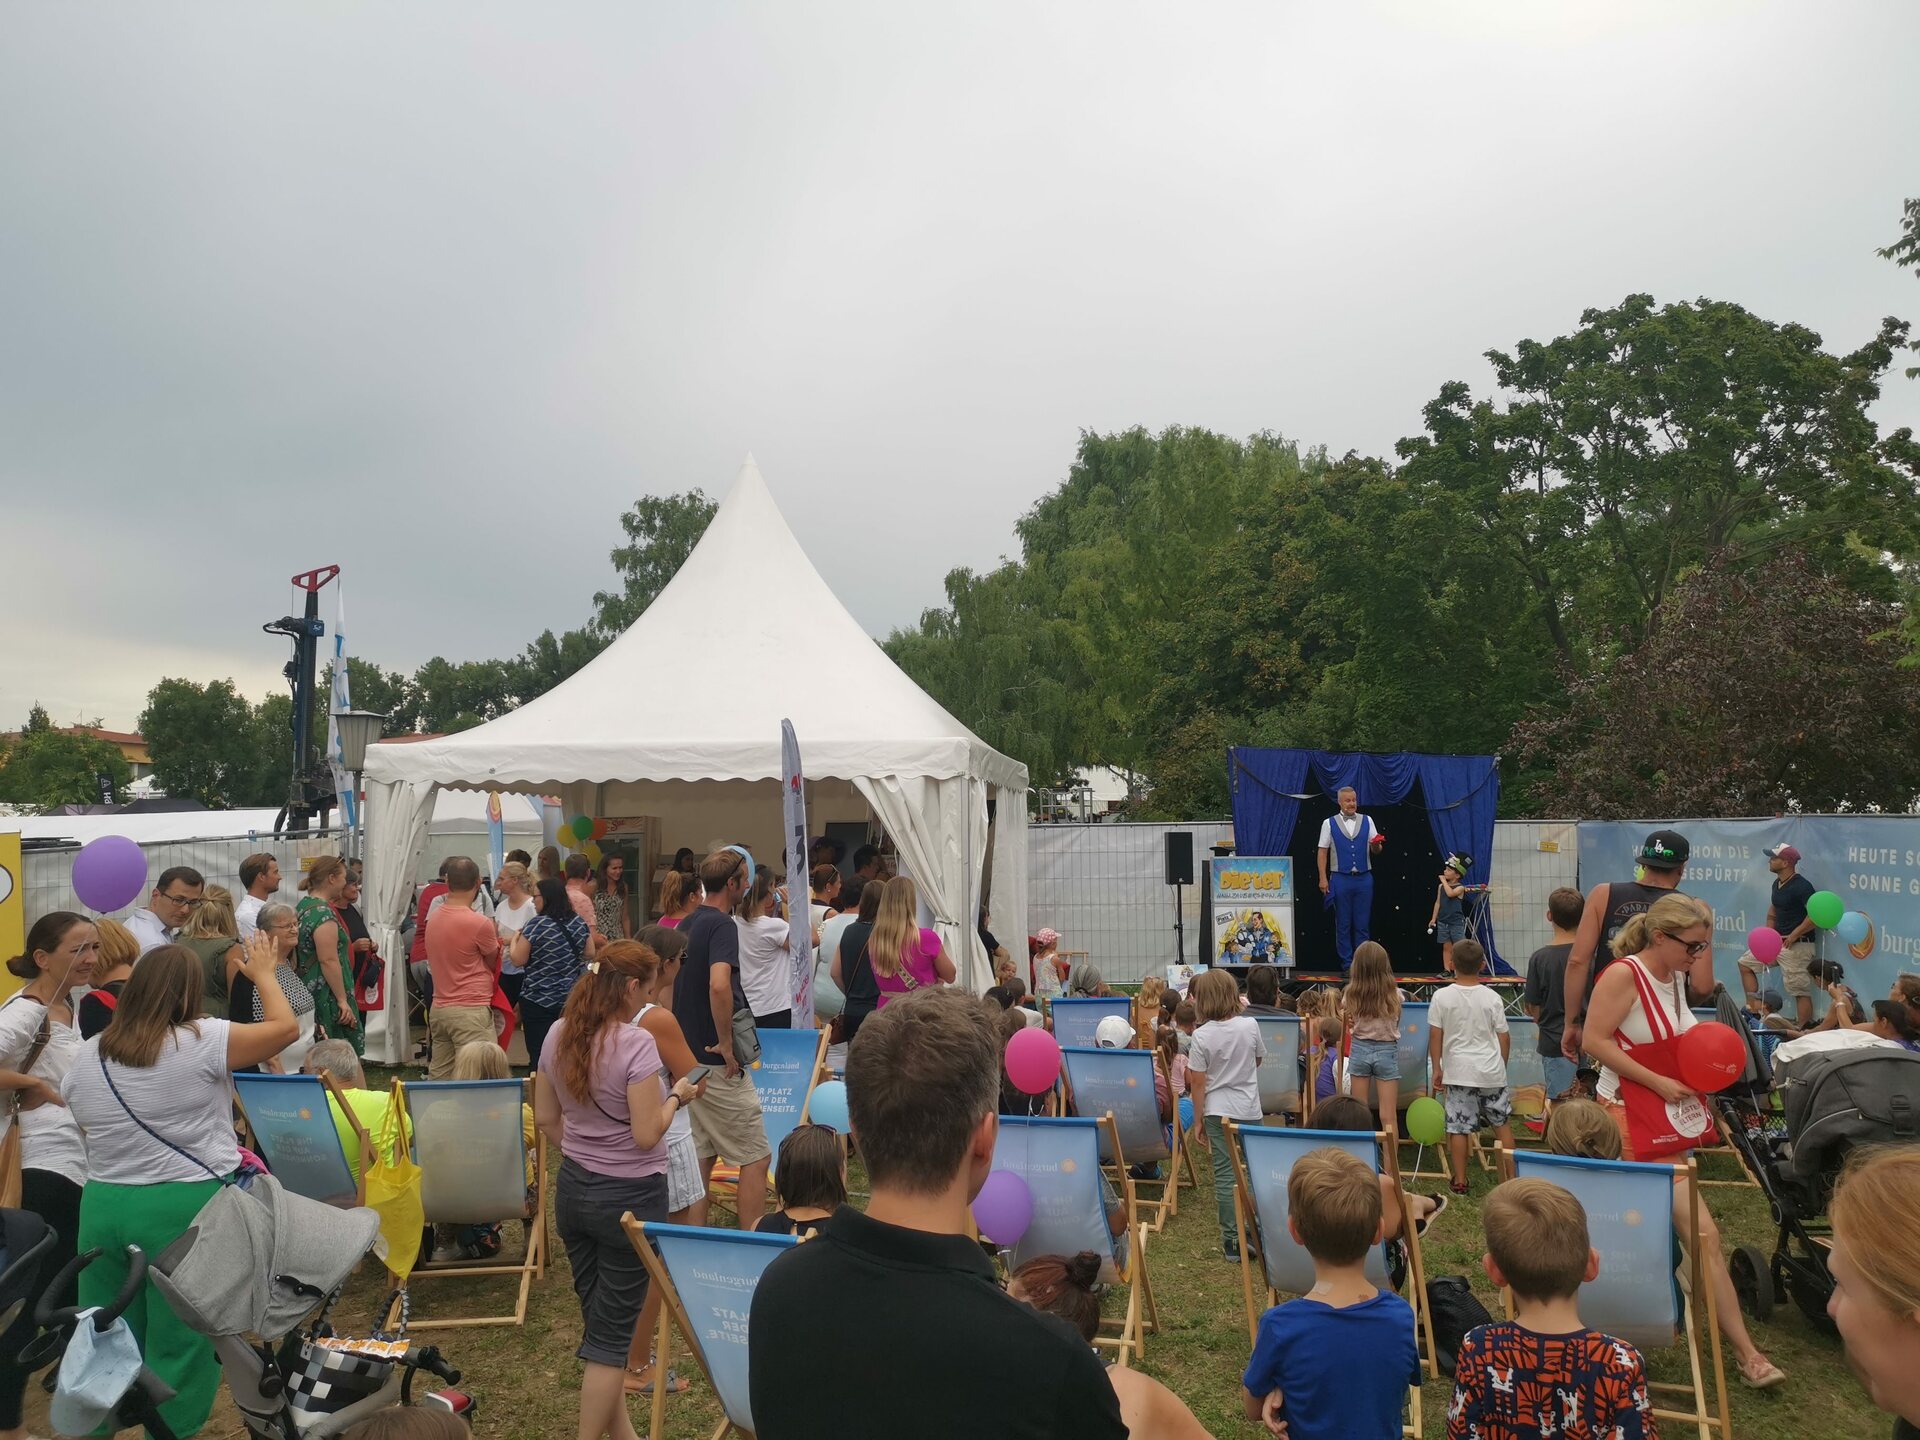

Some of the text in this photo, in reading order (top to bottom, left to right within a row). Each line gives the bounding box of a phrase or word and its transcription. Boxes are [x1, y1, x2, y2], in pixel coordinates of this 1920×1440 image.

[1728, 846, 1750, 859] DIE
[1848, 846, 1897, 865] HEUTE
[1681, 863, 1748, 882] GESPÜRT?
[1849, 873, 1901, 893] SONNE
[762, 1061, 800, 1071] burgenland
[767, 1087, 793, 1096] PLATZ
[758, 1096, 788, 1104] UF DER
[760, 1105, 798, 1113] ENSEITE.
